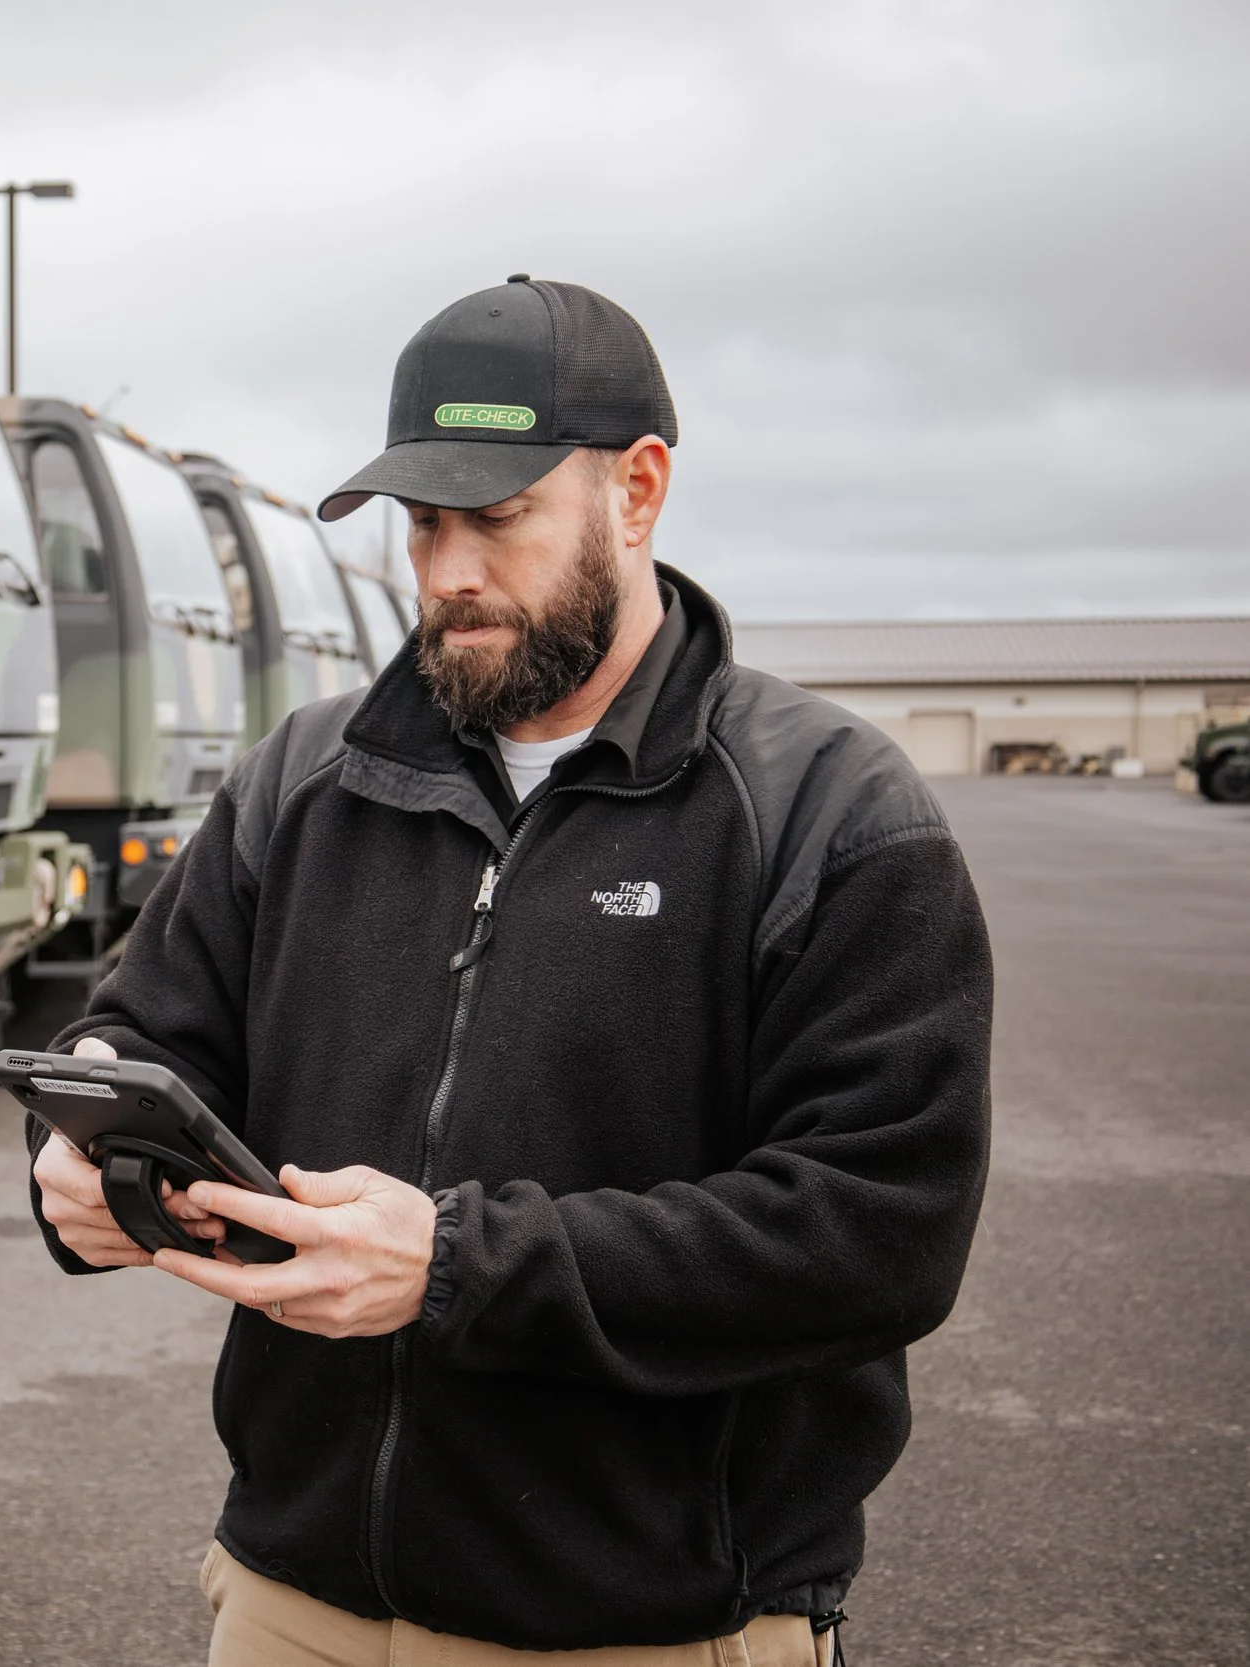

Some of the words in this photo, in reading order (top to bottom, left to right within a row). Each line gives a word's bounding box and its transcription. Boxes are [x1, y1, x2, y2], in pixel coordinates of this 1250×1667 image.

[440, 409, 530, 425] LITE-CHECK
[618, 881, 645, 893] THE
[590, 890, 642, 904] NORTH
[601, 904, 637, 916] FACE
[35, 1080, 80, 1093] NATHAN
